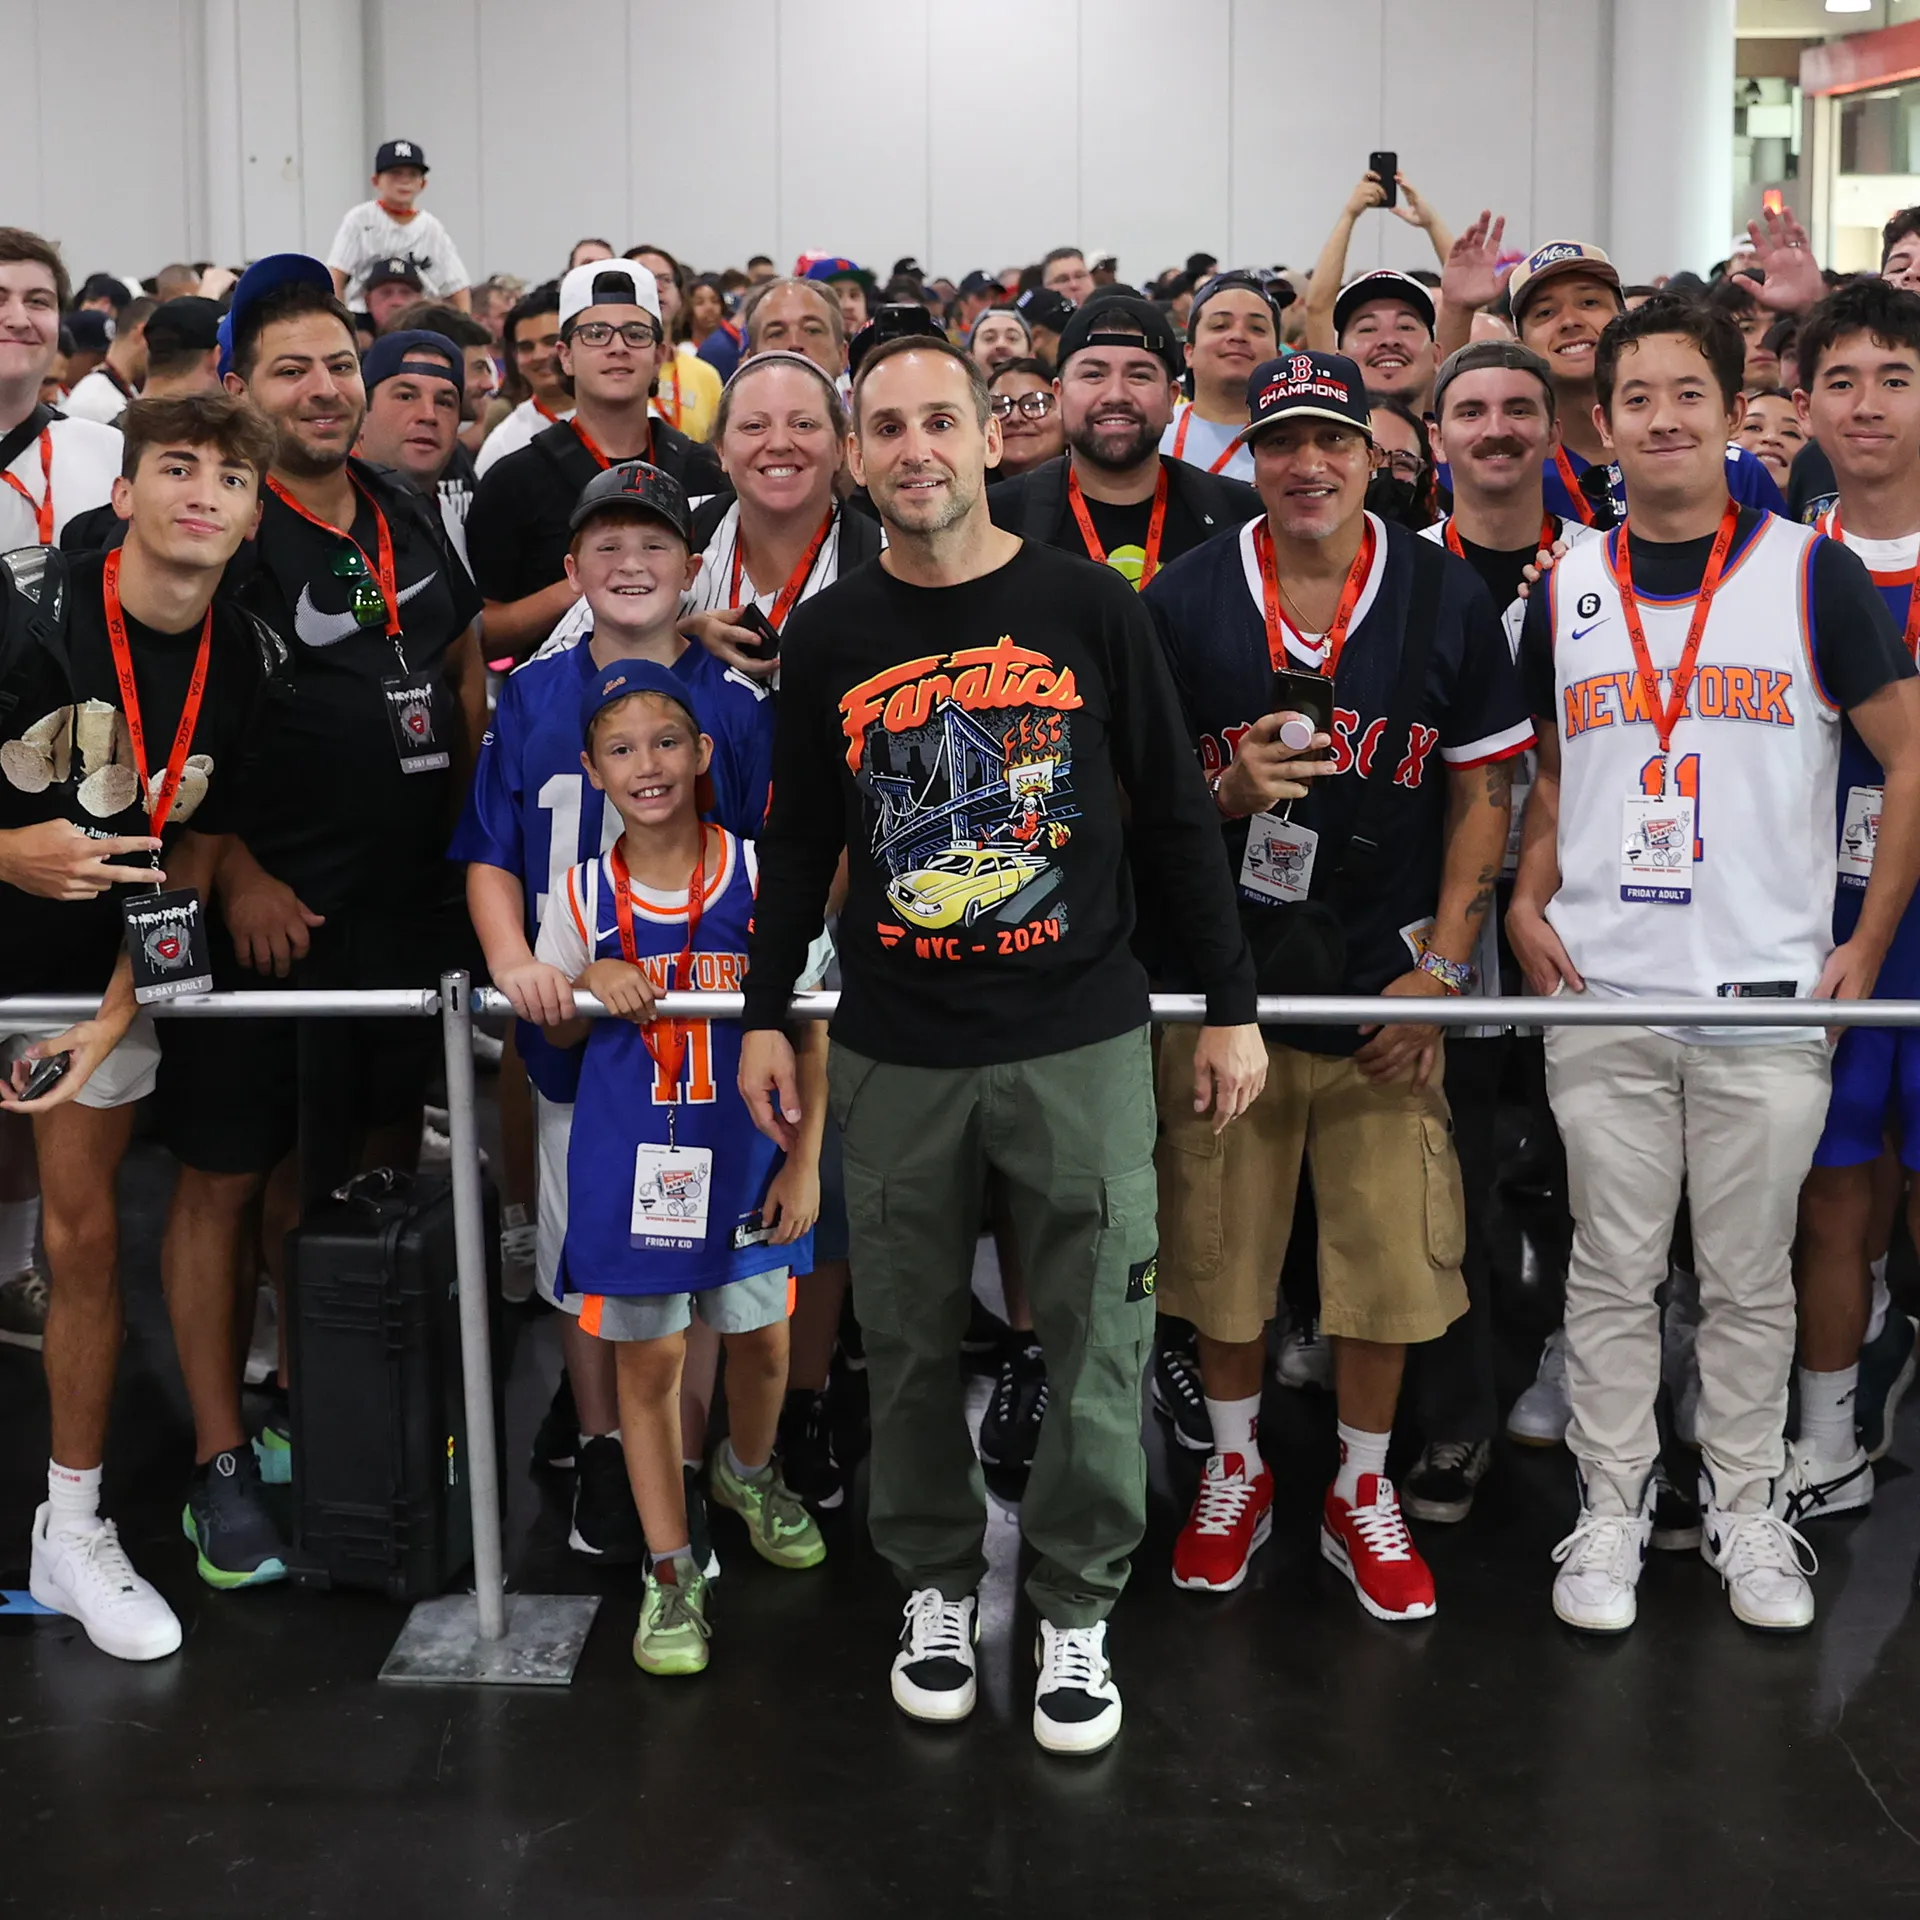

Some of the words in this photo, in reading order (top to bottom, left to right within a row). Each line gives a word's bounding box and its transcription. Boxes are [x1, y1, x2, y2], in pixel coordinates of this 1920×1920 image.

[1534, 246, 1578, 270] Mets
[1288, 354, 1313, 384] B
[1259, 383, 1349, 410] CHAMPIONS
[617, 466, 655, 494] T
[1582, 596, 1597, 614] 6
[838, 634, 1084, 777] Fanatics
[1564, 669, 1663, 743] NEW
[1003, 712, 1063, 765] FEST
[1842, 875, 1867, 887] FRIDA
[1244, 888, 1272, 905] FRIDAY
[1627, 888, 1658, 899] FRIDAY
[1658, 890, 1685, 900] ADULT
[914, 936, 961, 961] NYC
[997, 917, 1060, 955] 2024
[146, 985, 173, 998] 3-DAY
[175, 979, 203, 993] ADULT
[645, 1237, 677, 1248] FRIDAY
[678, 1238, 693, 1249] KID
